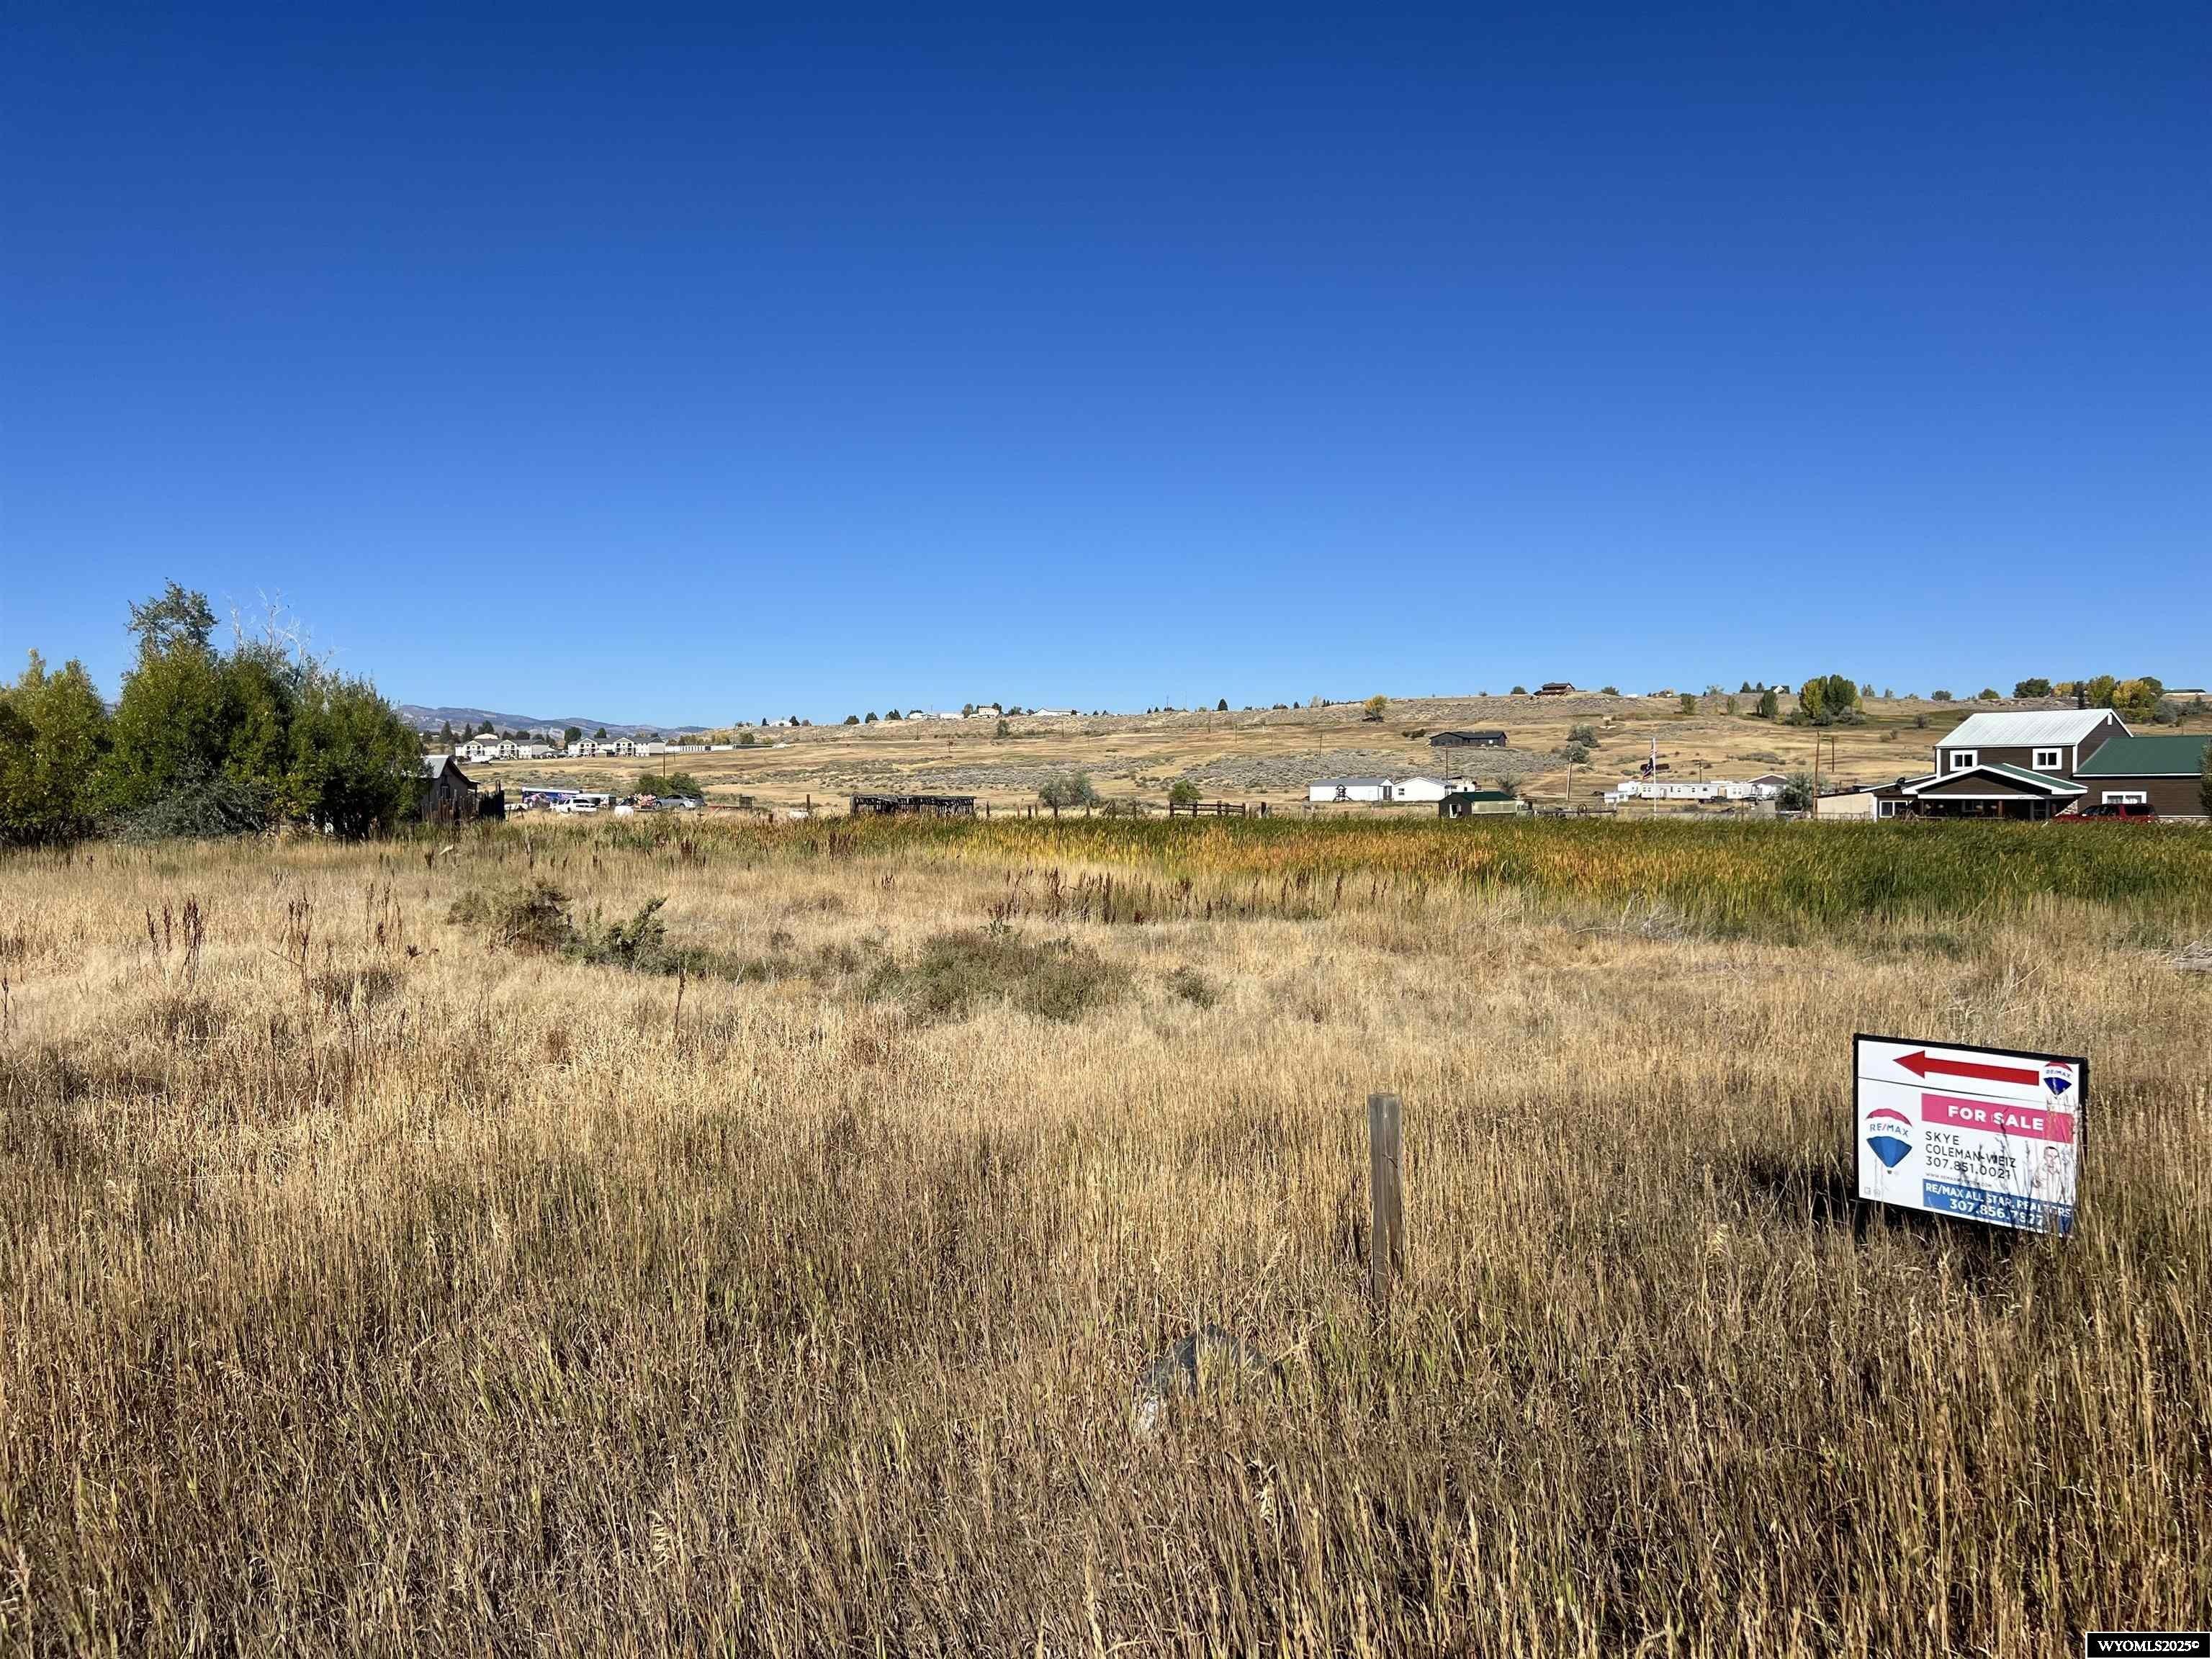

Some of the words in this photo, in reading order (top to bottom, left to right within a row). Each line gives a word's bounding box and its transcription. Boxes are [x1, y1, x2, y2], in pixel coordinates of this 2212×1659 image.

[1948, 1105, 1986, 1123] FOR
[1992, 1112, 2044, 1131] SALE
[1869, 1123, 1909, 1138] RE/MAX
[1925, 1130, 1959, 1145] SKYE
[1925, 1156, 2010, 1179] 307.851.0021
[1925, 1182, 1964, 1199] RE/MAX
[1966, 1190, 1984, 1202] ALL
